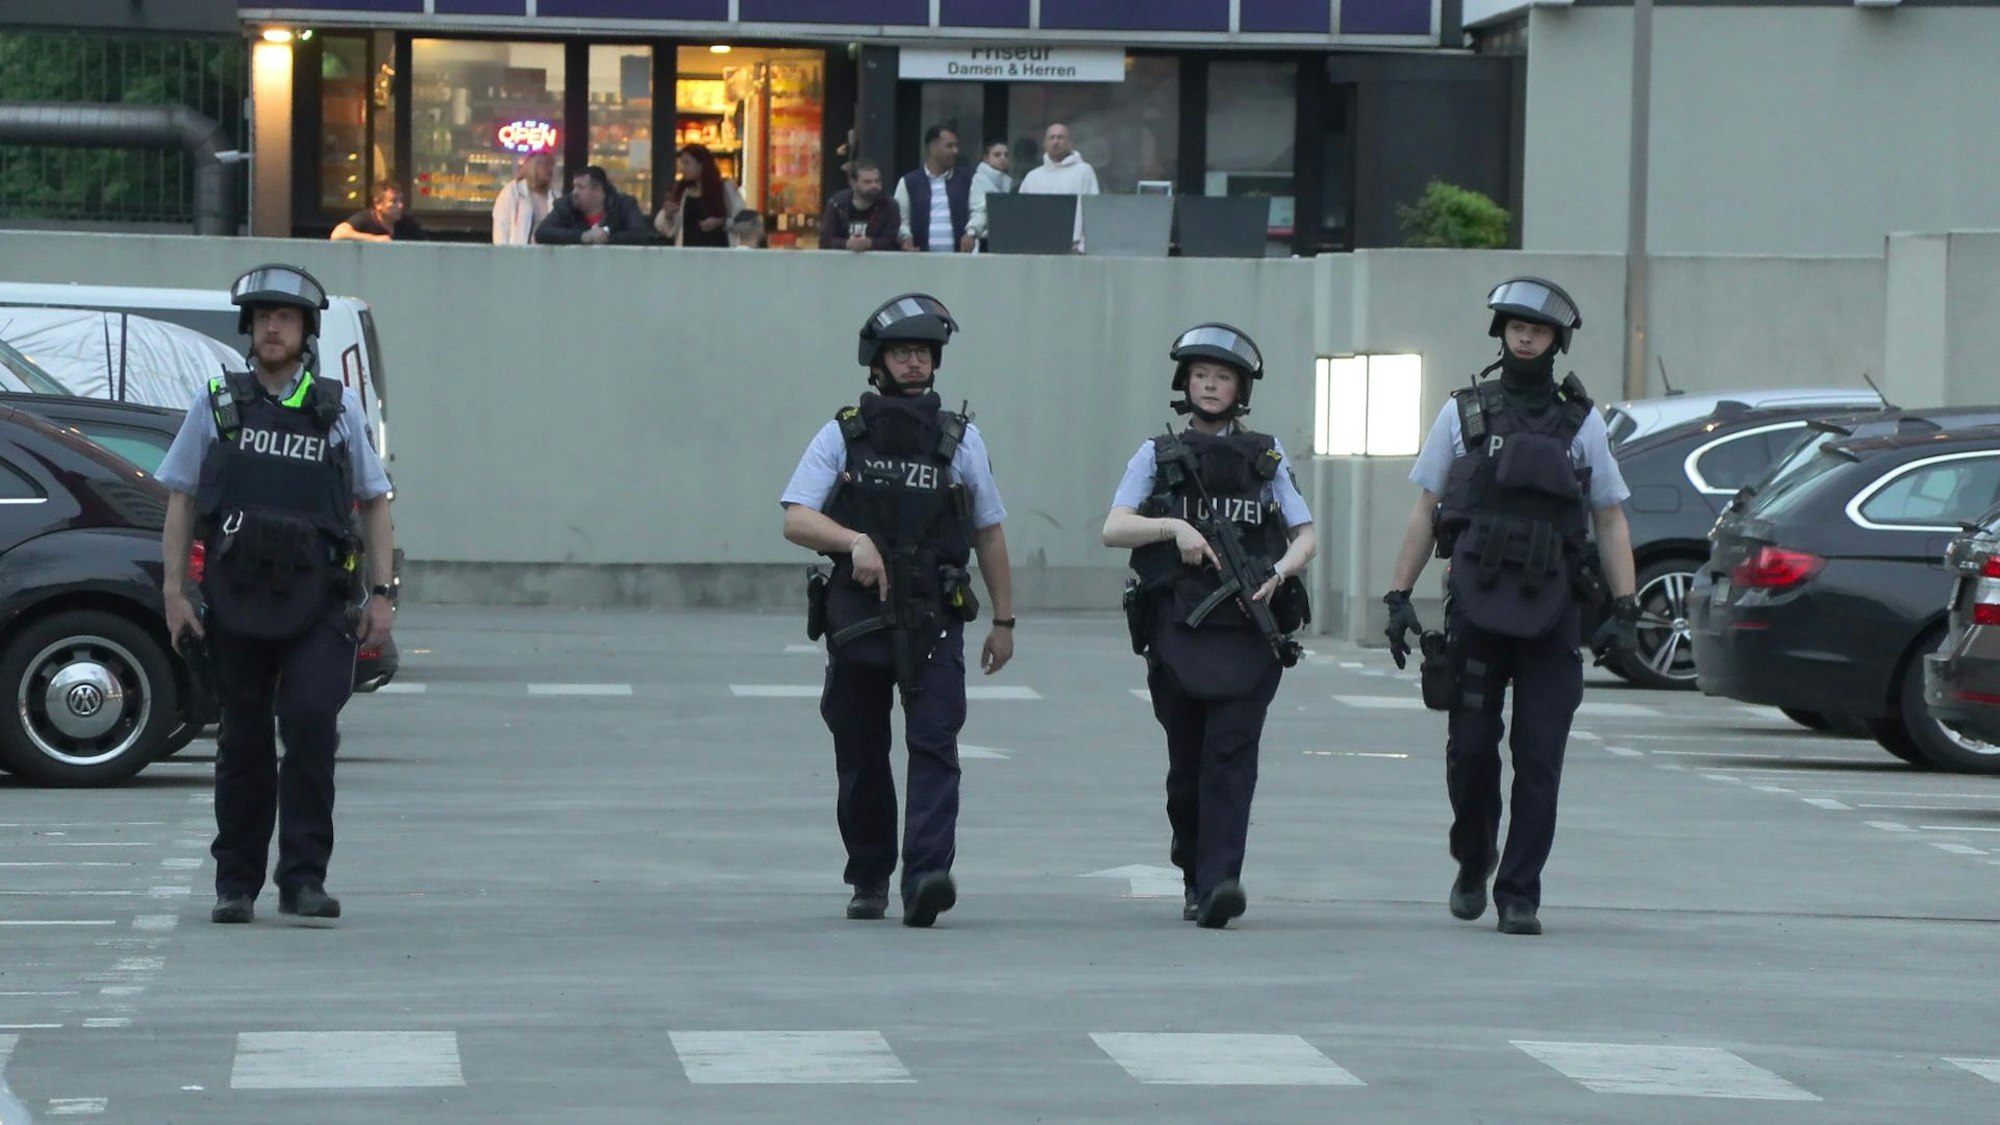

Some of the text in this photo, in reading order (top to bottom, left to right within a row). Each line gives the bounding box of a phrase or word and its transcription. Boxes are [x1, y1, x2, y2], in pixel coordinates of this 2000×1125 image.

[948, 62, 1077, 77] Damen & Herren
[498, 125, 557, 147] OPEN
[239, 427, 326, 462] POLIZEI
[857, 459, 939, 489] OZEI
